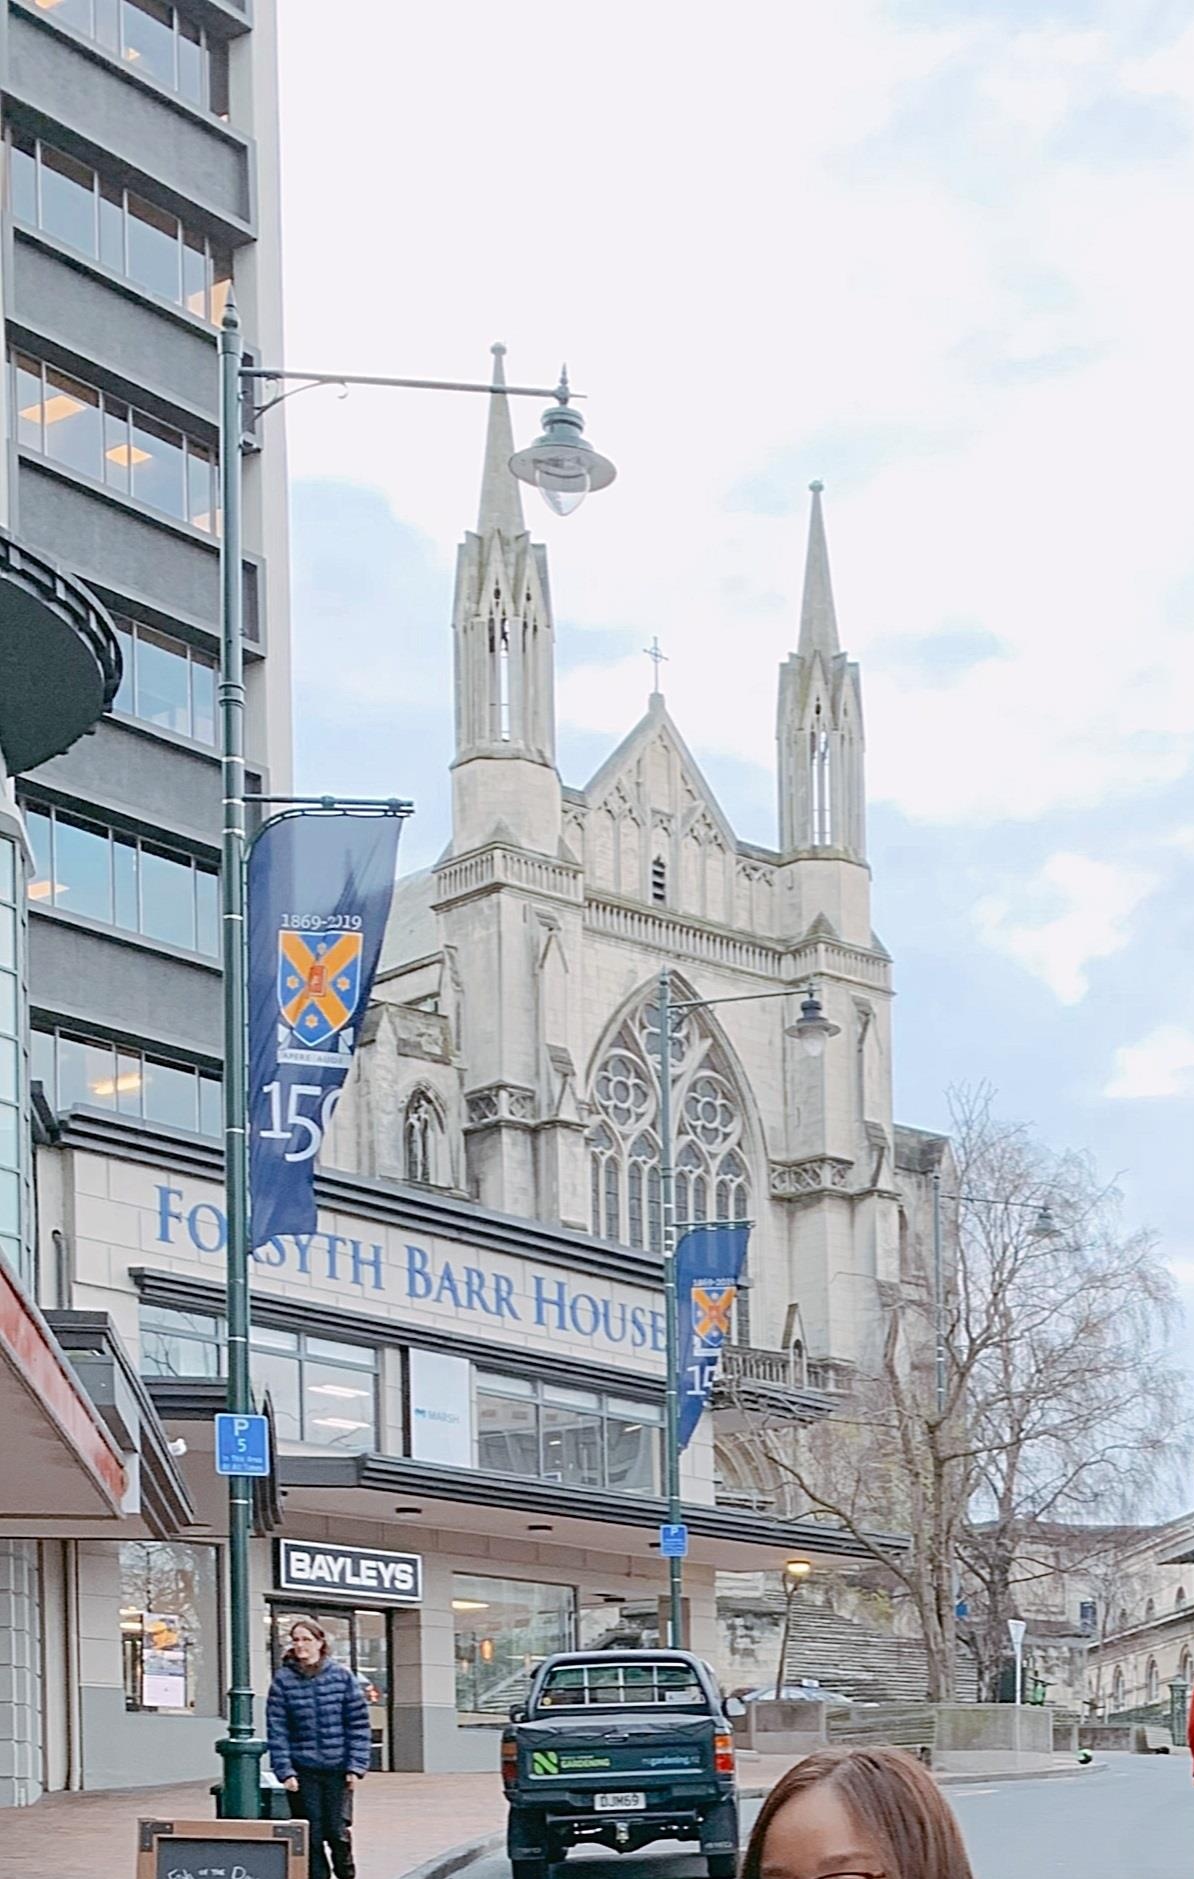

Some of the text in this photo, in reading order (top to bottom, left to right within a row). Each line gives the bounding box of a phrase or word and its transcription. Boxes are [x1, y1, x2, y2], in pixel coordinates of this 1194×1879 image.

[153, 1184, 667, 1351] FOSYTH BARR HOUSE
[234, 1418, 249, 1436] P
[238, 1438, 247, 1452] 5
[289, 1550, 414, 1591] BAYLEYS
